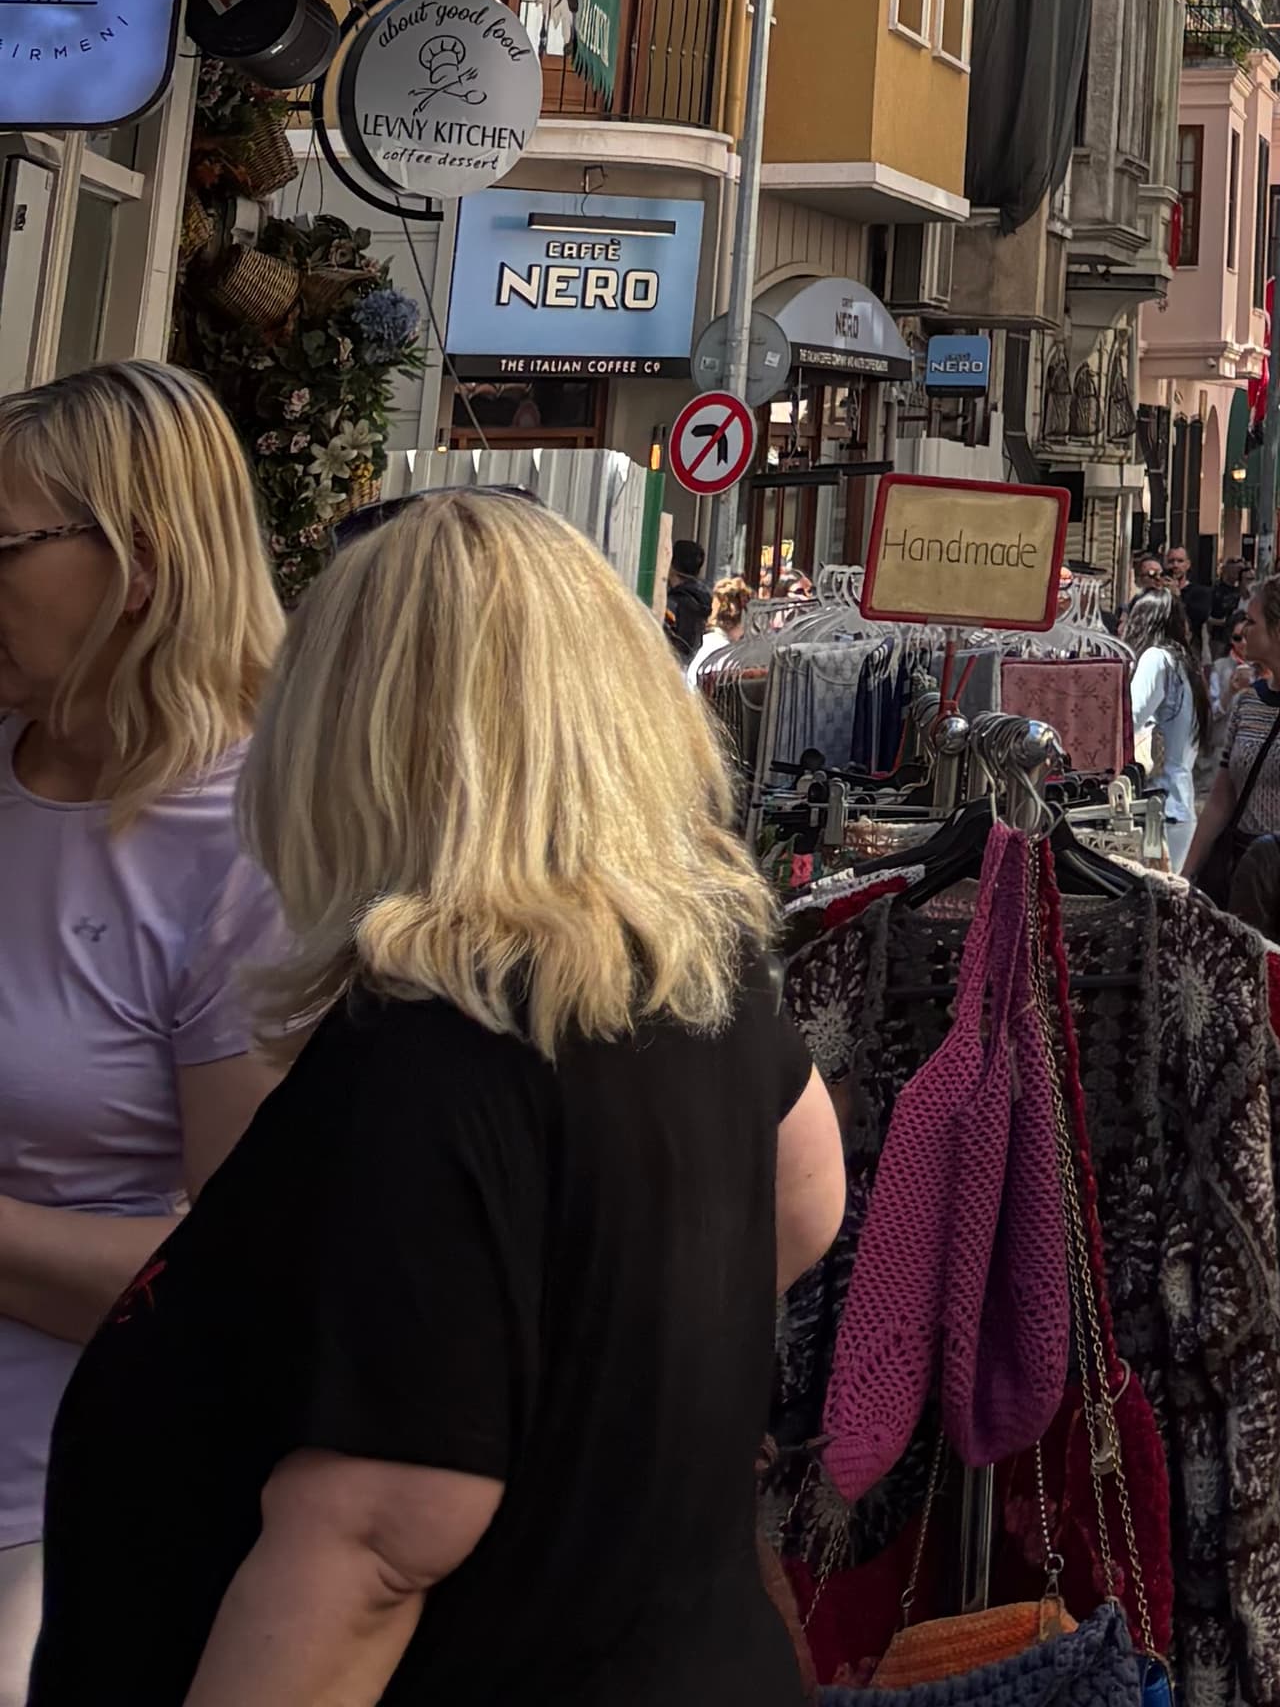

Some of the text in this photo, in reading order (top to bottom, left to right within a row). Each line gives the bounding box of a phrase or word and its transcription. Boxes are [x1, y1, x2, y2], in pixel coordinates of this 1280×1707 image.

[378, 1, 532, 62] about good food
[362, 113, 526, 151] LEVNY KITCHEN
[382, 147, 500, 170] coffee dessert
[546, 237, 622, 261] CAFFÈ
[496, 261, 660, 312] NERO
[835, 310, 859, 339] NERO
[499, 359, 525, 373] THE
[529, 359, 583, 374] ITALIAN
[587, 360, 637, 374] COFFEE
[931, 360, 983, 373] NERO
[881, 527, 1038, 569] Handmade
